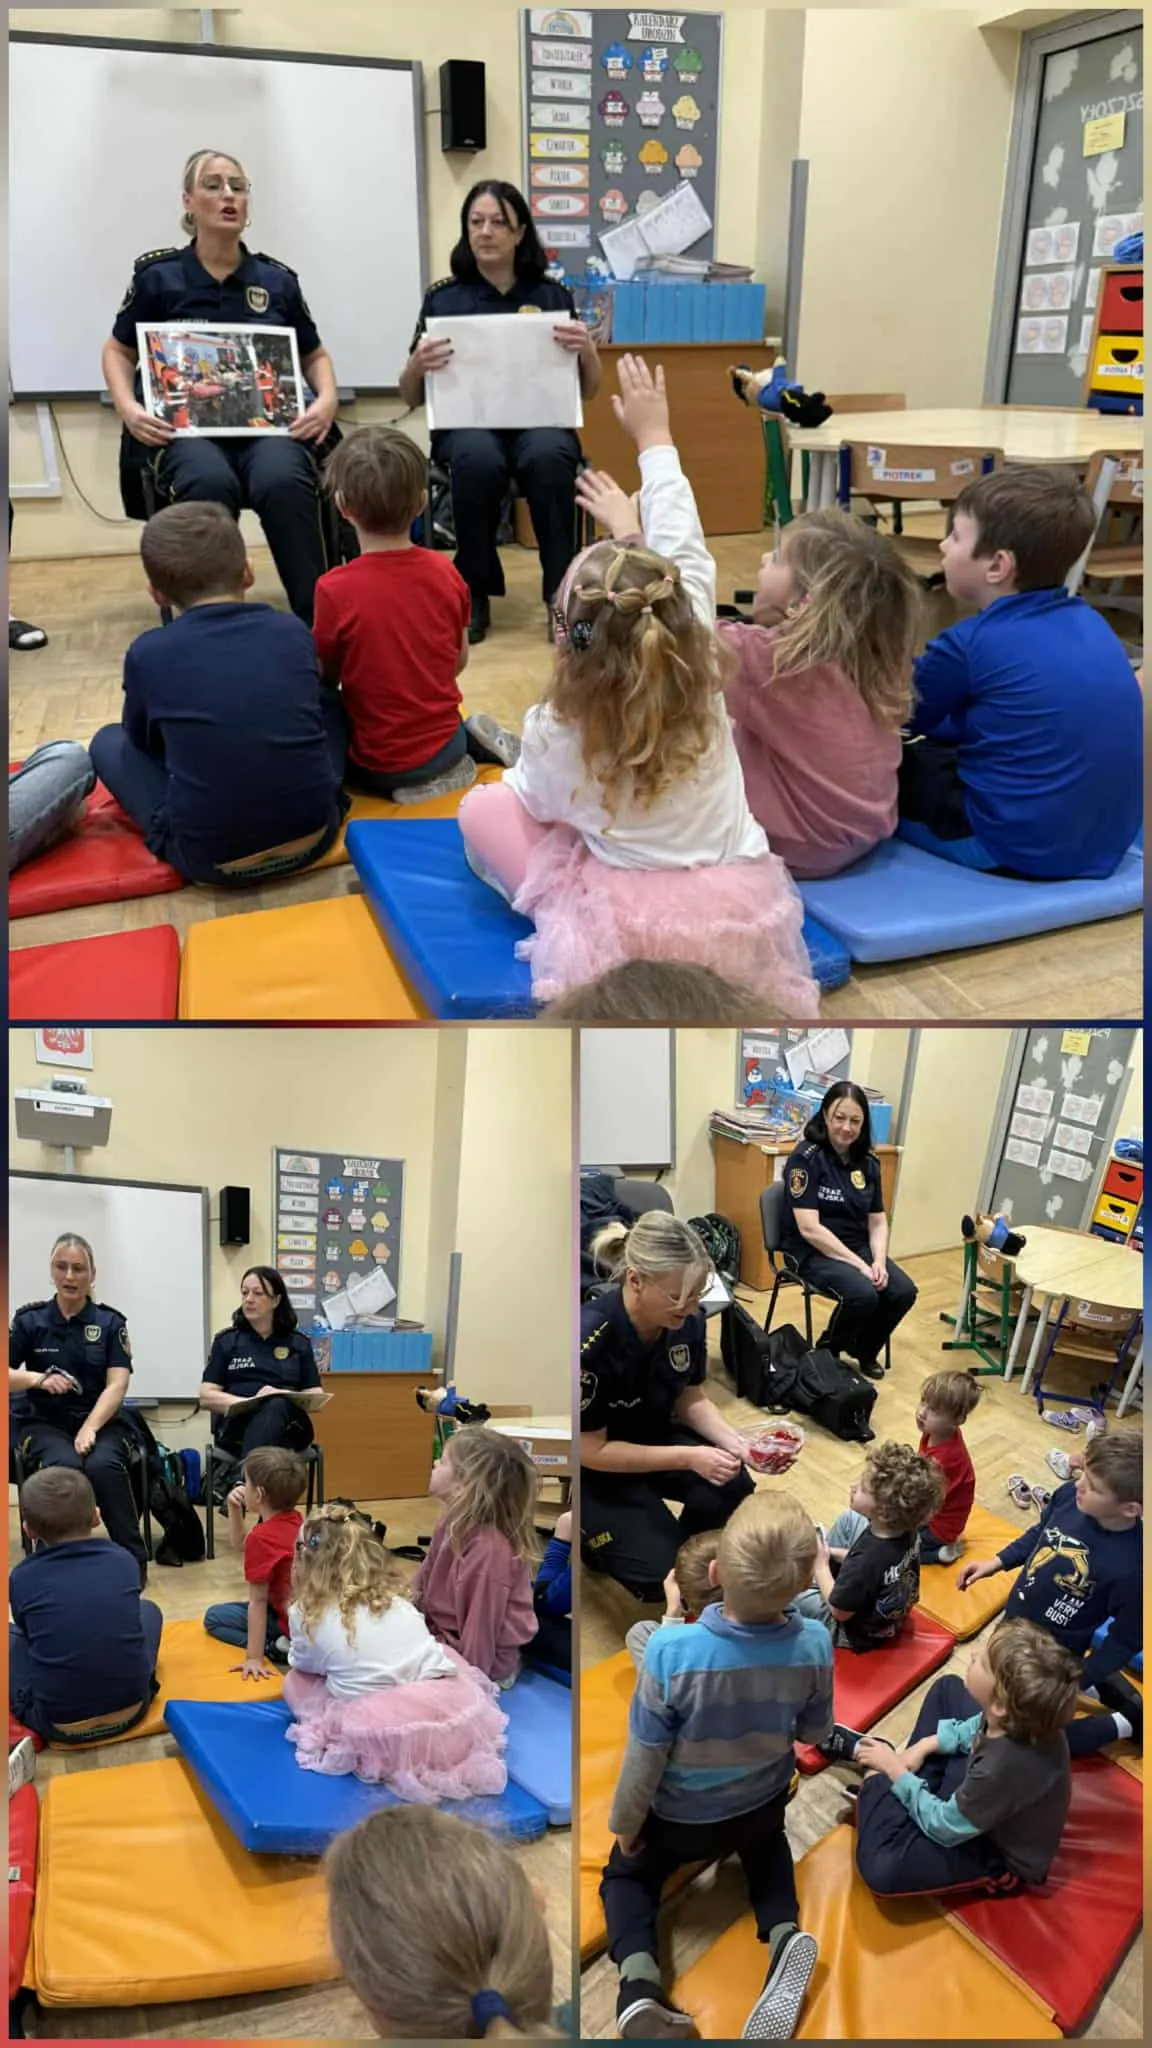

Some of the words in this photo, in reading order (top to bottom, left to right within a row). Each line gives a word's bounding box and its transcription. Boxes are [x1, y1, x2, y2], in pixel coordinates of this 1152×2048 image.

[883, 471, 922, 480] PIOTREK
[1063, 1593, 1068, 1601] I
[1054, 1598, 1078, 1618] VERY
